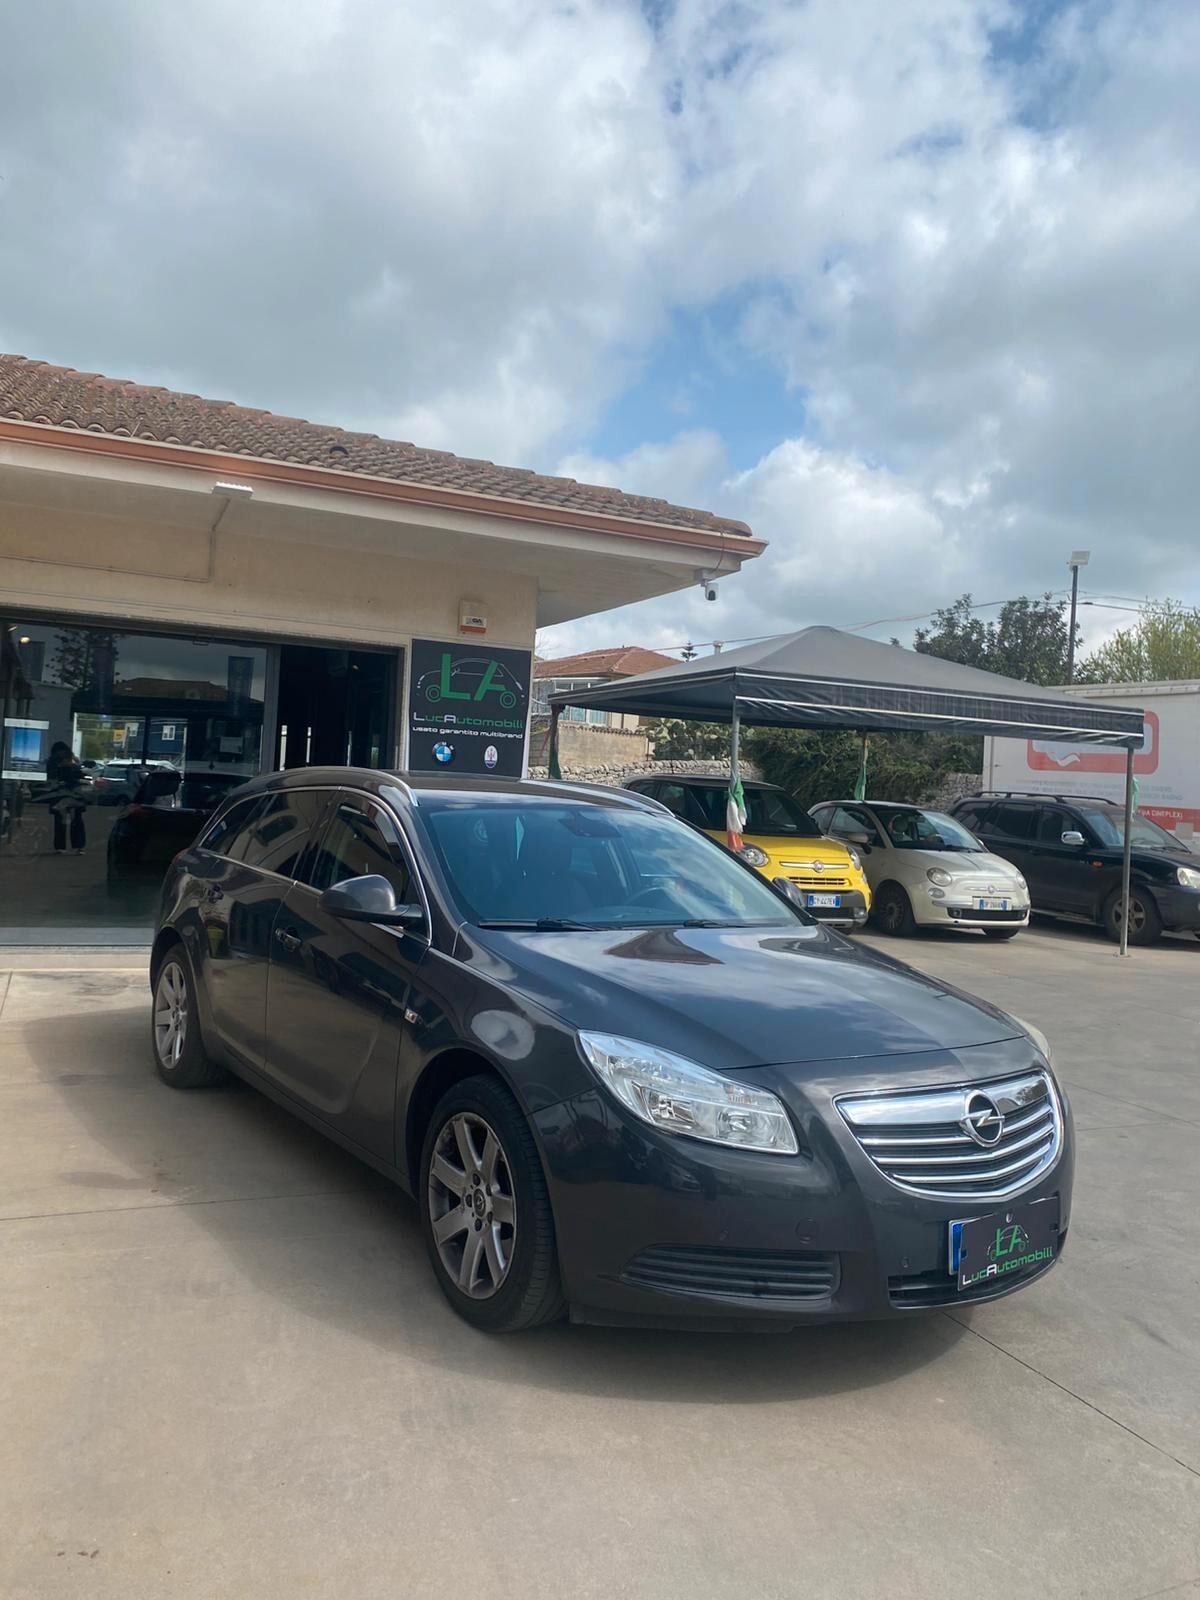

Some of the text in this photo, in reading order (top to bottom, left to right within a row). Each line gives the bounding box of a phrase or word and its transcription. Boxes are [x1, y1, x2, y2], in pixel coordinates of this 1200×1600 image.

[413, 712, 523, 729] LucAutomobili
[439, 728, 479, 736] garantito
[480, 730, 523, 739] multibrand
[962, 1247, 1052, 1285] LucAutomobili
